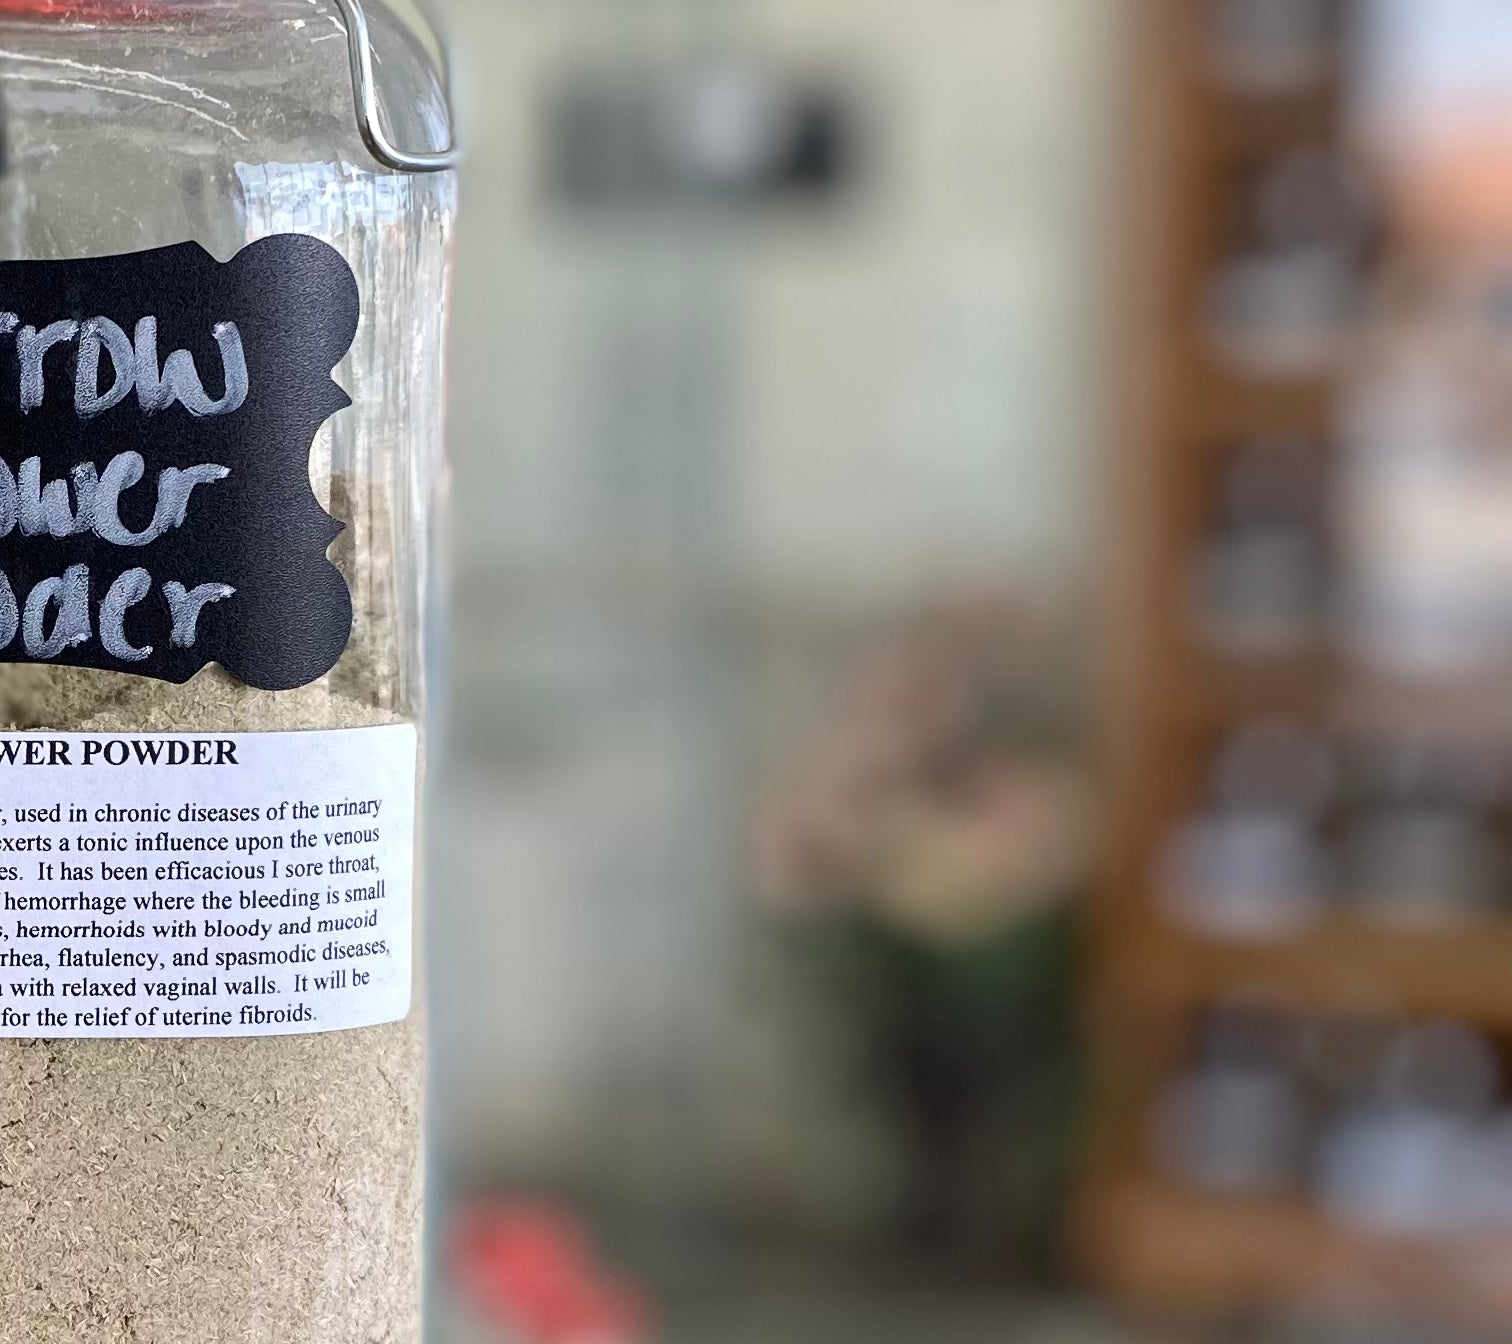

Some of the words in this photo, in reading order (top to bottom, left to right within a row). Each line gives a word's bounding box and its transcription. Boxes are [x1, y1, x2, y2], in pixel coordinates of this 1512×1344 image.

[79, 739, 240, 766] POWDER
[14, 802, 62, 823] used
[67, 802, 88, 823] in
[94, 802, 172, 823] chronic
[177, 802, 261, 823] diseases
[265, 800, 290, 821] of
[291, 800, 320, 820] the
[324, 797, 383, 819] urinary
[58, 837, 71, 852] a
[75, 831, 129, 852] tonic
[134, 831, 229, 852] influence
[235, 835, 285, 857] upon
[289, 828, 318, 849] the
[323, 827, 380, 847] venous
[36, 861, 55, 881] It
[59, 861, 94, 881] has
[100, 860, 149, 881] been
[154, 860, 265, 881] efficacious
[271, 859, 280, 879] I
[285, 862, 324, 879] sore
[328, 854, 380, 875] throat,
[3, 890, 127, 916] hemorrhage
[132, 890, 196, 911] where
[200, 890, 233, 910] the
[238, 887, 321, 911] bleeding
[326, 885, 340, 905] is
[344, 878, 386, 903] small
[15, 919, 146, 939] hemorrhoids
[151, 919, 197, 938] with
[203, 918, 273, 942] bloody
[277, 915, 312, 936] and
[316, 908, 378, 933] mucoid
[57, 947, 166, 972] flatulency,
[172, 946, 209, 967] and
[214, 943, 317, 972] spasmodic
[321, 939, 390, 961] diseases,
[9, 976, 55, 997] with
[61, 976, 137, 998] relaxed
[142, 976, 218, 1002] vaginal
[223, 974, 282, 996] walls.
[293, 973, 309, 993] It
[313, 968, 347, 991] will
[352, 967, 370, 987] be
[0, 1006, 31, 1027] for
[35, 1007, 68, 1027] the
[73, 1006, 133, 1027] relief
[134, 1006, 160, 1027] of
[162, 1005, 233, 1026] uterine
[238, 1002, 317, 1025] fibroids.
